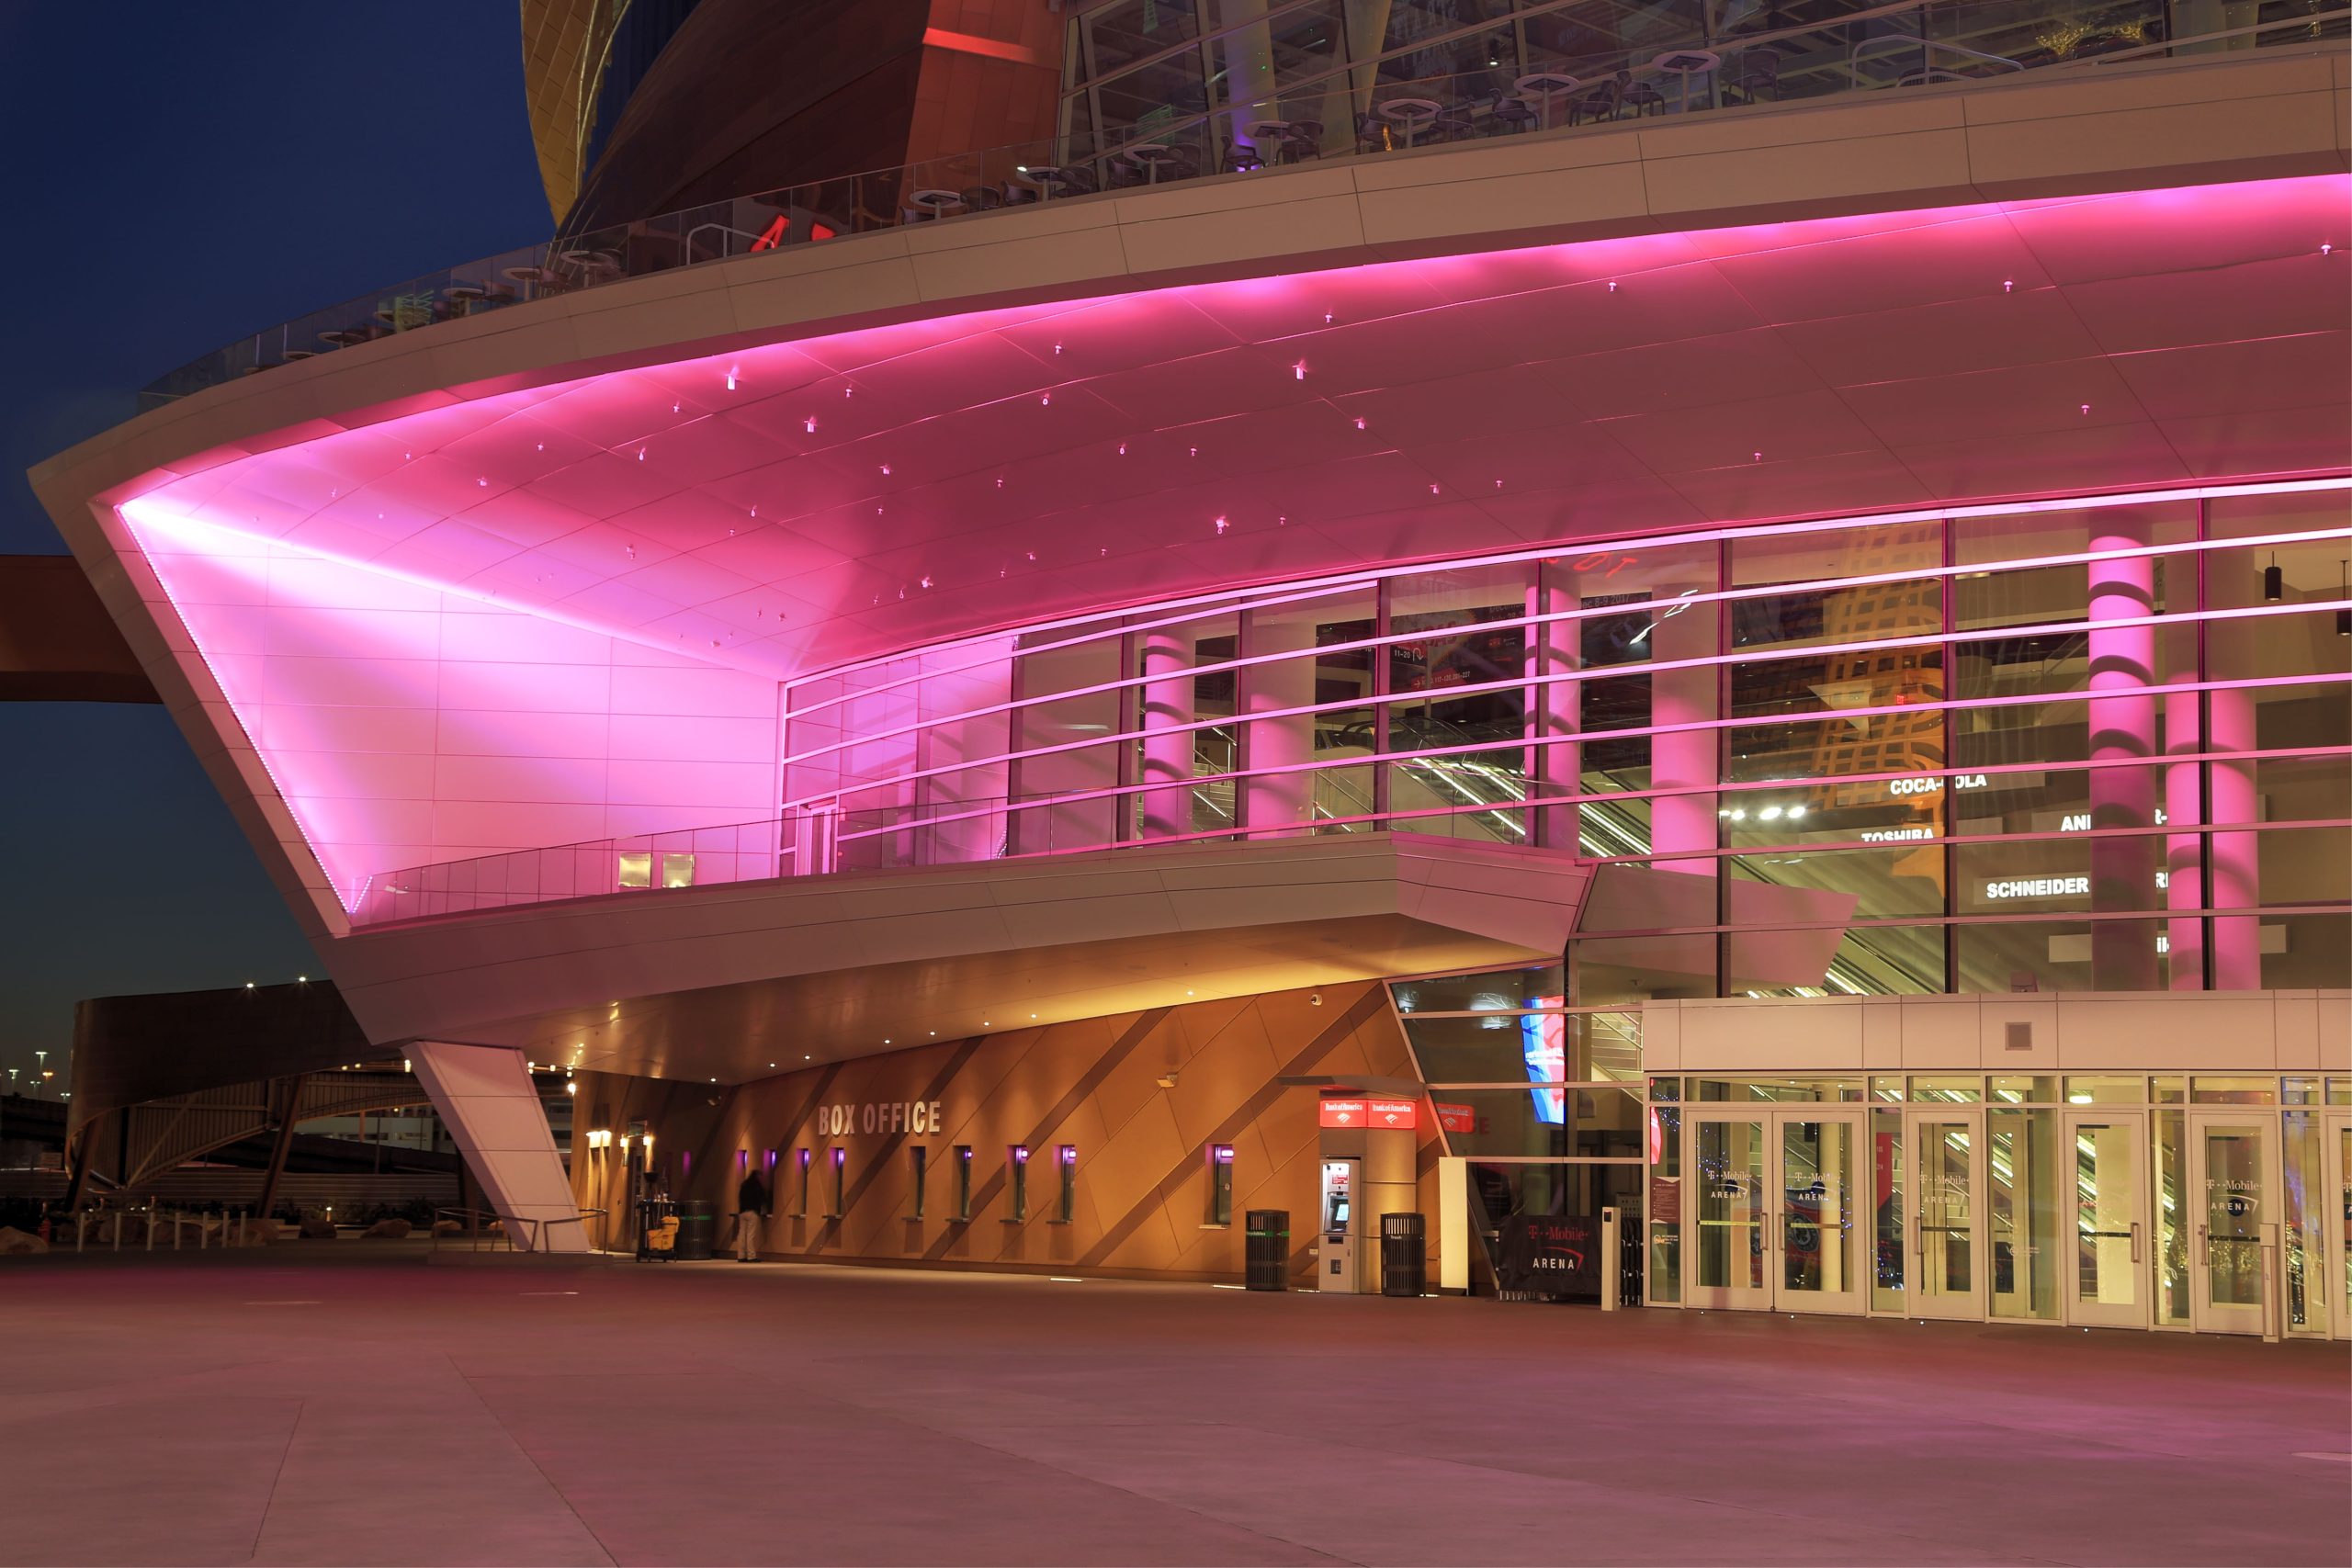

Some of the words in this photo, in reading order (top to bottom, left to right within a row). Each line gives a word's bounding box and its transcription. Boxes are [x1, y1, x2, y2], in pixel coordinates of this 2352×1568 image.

[1394, 649, 1411, 659] 11-20
[1890, 773, 1987, 795] COCA-OLA
[1861, 828, 1934, 842] TOSHIBA
[1986, 877, 2089, 898] SCHNEIDER
[819, 1104, 856, 1135] BOX
[863, 1100, 941, 1134] OFFICE
[1711, 1190, 1742, 1200] ARENA
[1924, 1196, 1959, 1205] ARENA
[2211, 1202, 2250, 1212] ARENA
[1532, 1258, 1575, 1269] ARENA
